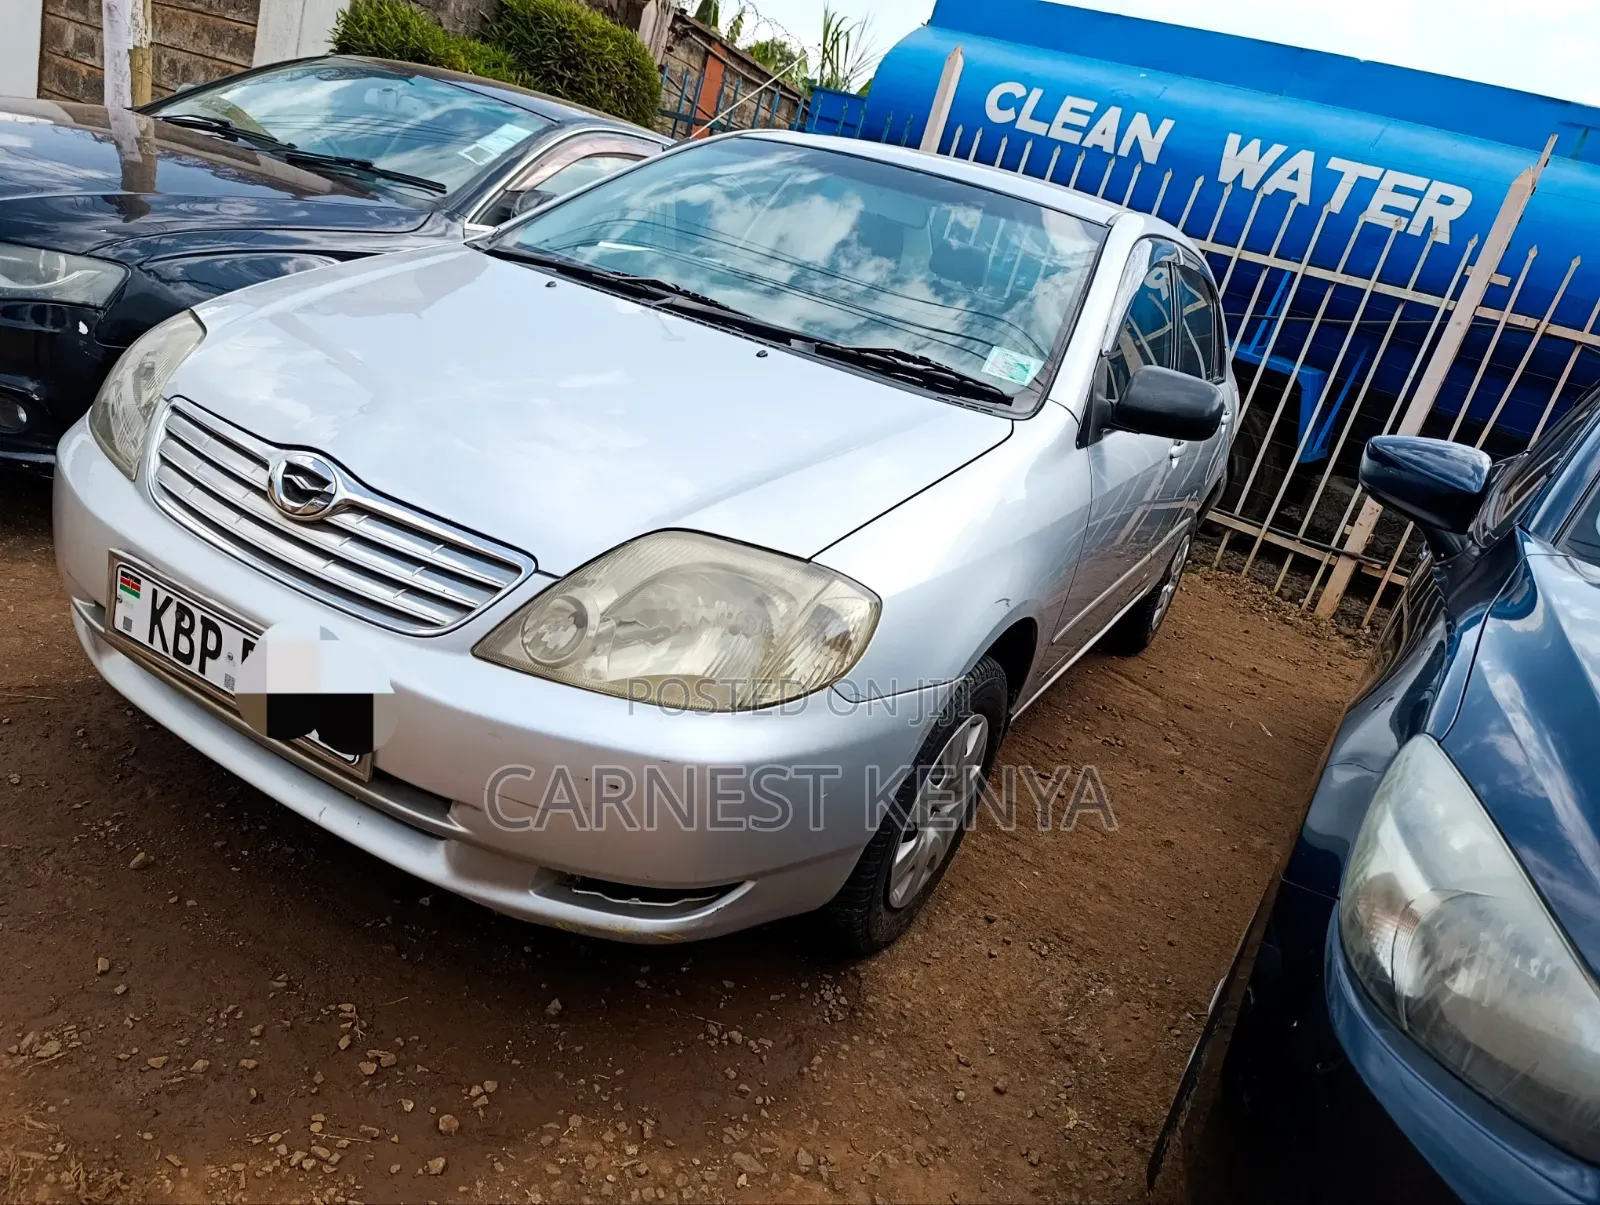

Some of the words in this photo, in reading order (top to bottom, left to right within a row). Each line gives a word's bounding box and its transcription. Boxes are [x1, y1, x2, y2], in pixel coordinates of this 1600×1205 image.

[985, 81, 1175, 164] CLEAN
[1217, 133, 1473, 244] WATER
[149, 588, 223, 675] KBP
